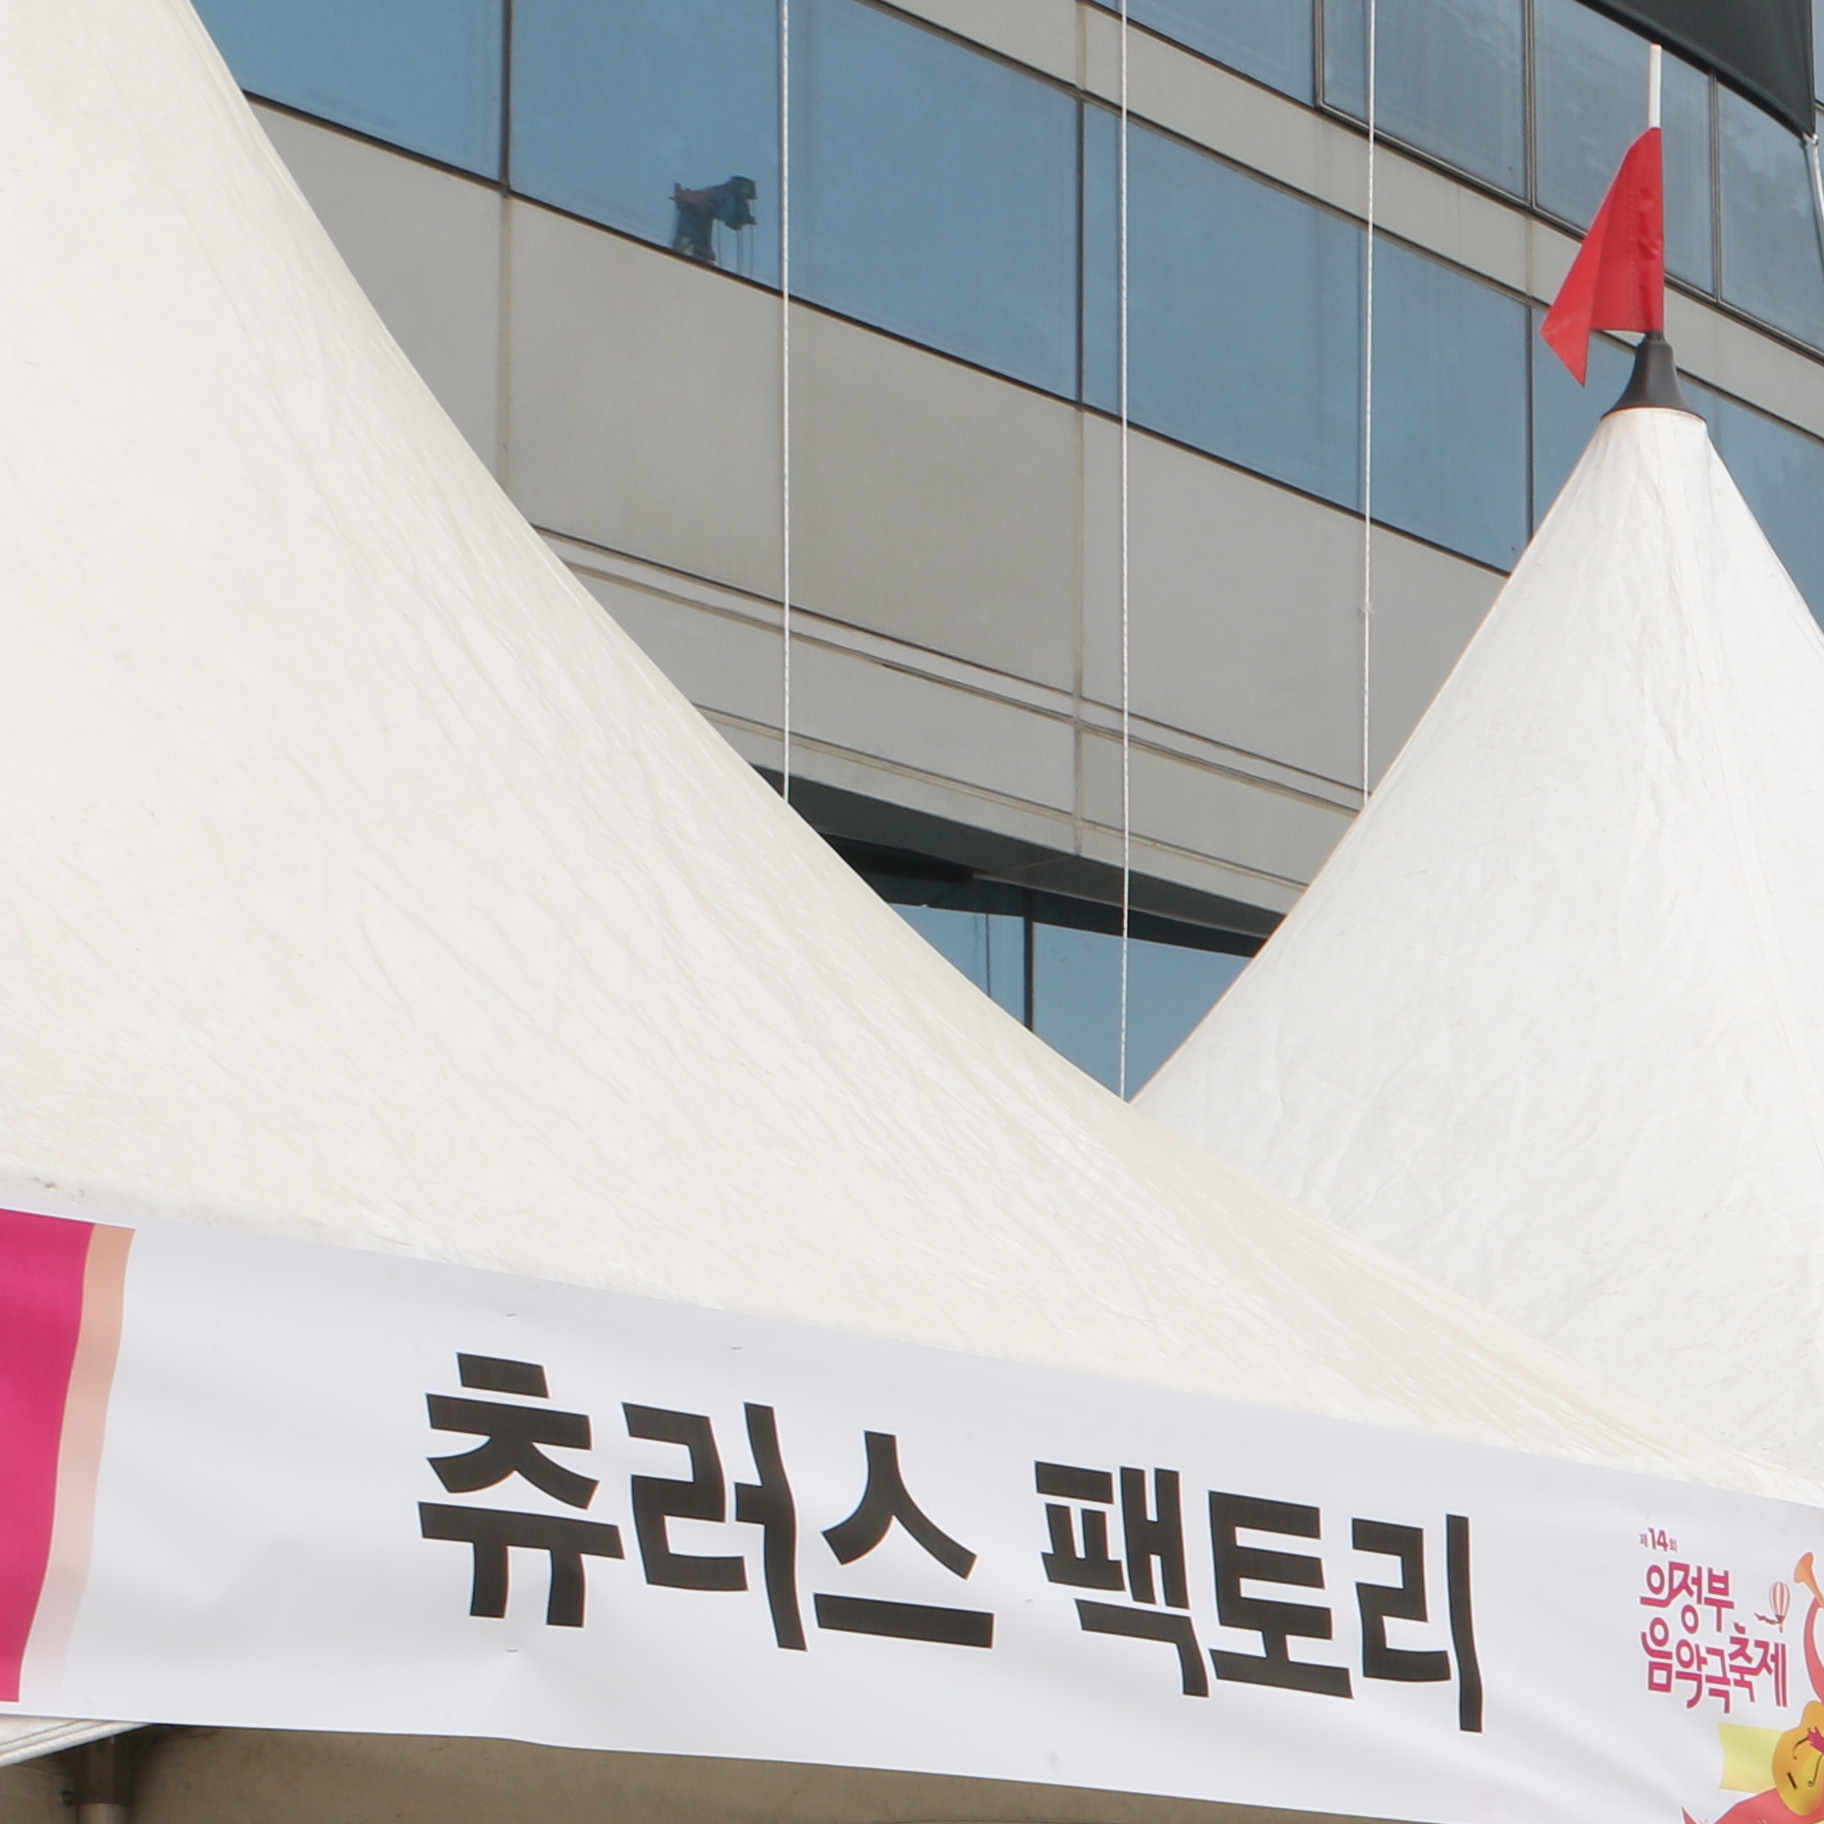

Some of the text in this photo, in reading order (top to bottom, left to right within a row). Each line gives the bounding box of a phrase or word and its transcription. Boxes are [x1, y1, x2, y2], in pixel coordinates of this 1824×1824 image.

[415, 1351, 1485, 1735] 츄러스 팩토리
[1639, 1560, 1736, 1635] 의정부
[1640, 1621, 1789, 1715] 음악극축제
